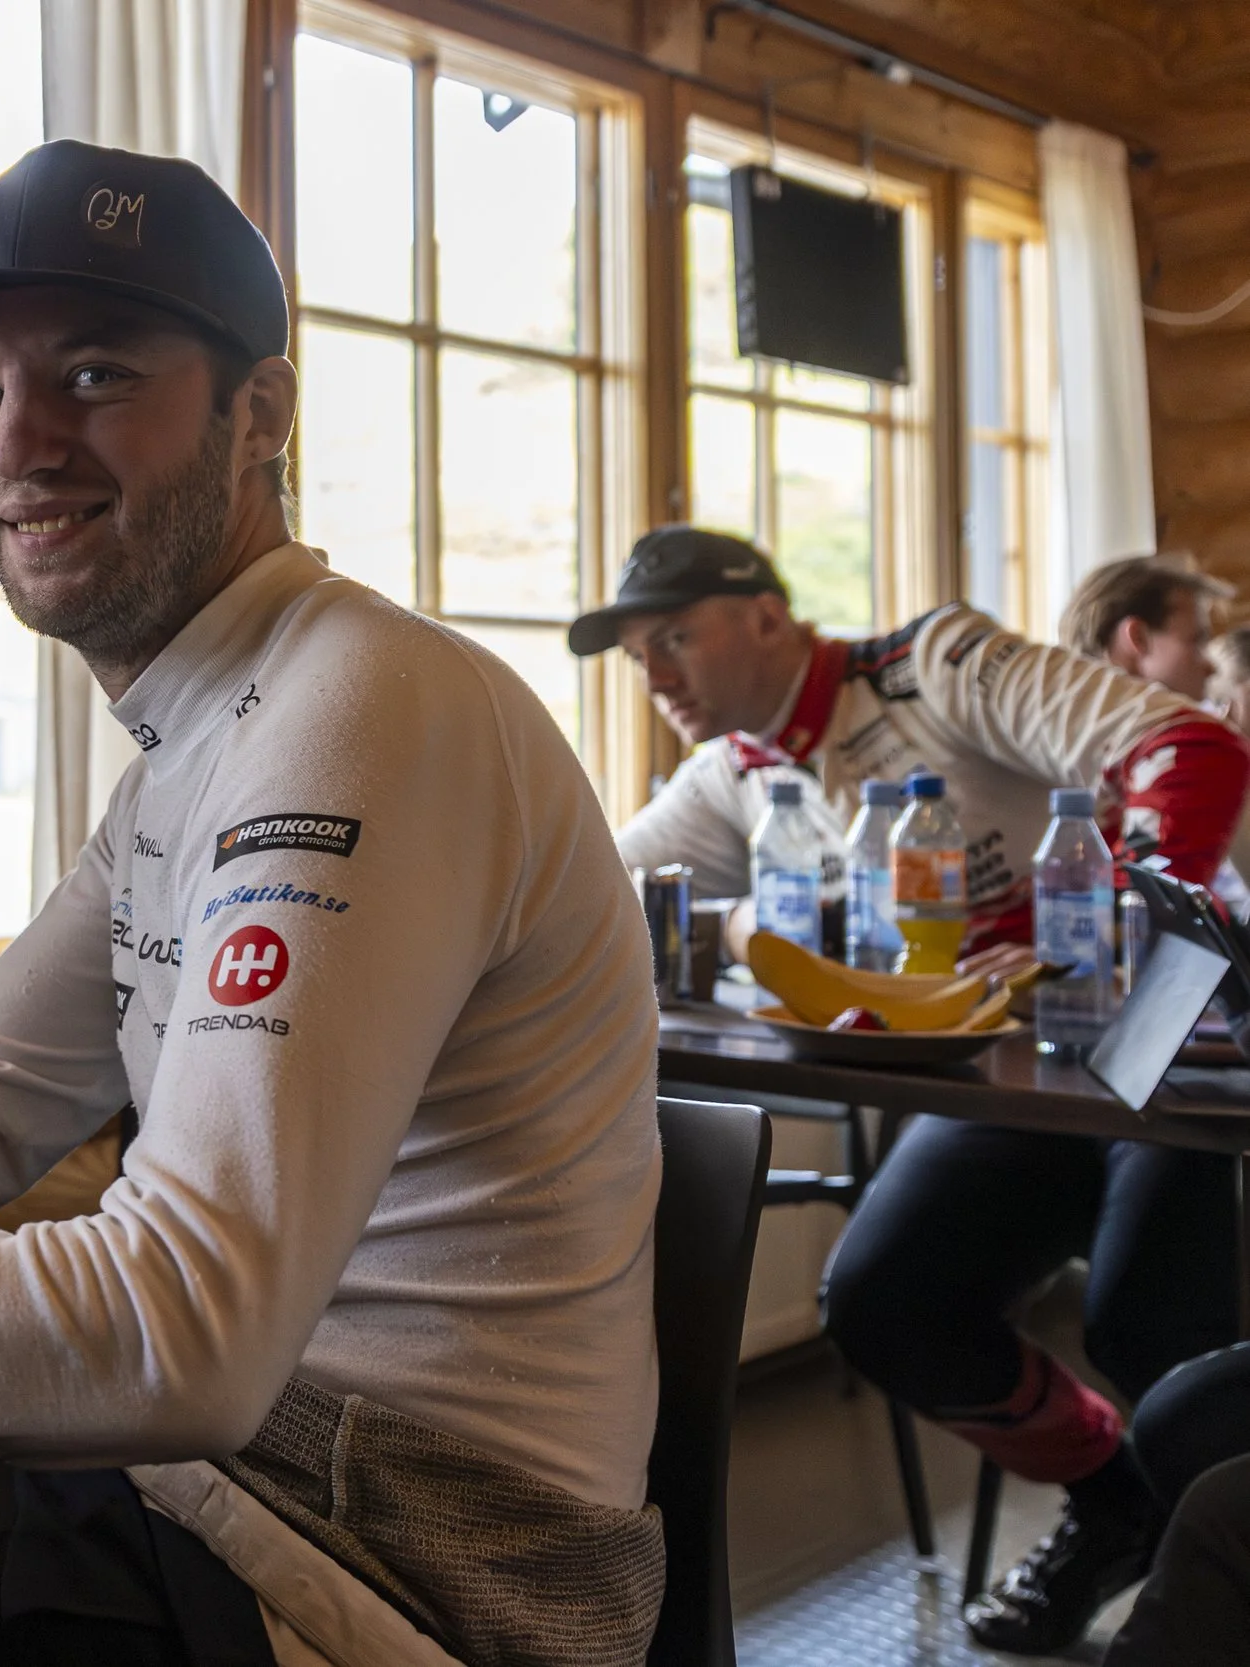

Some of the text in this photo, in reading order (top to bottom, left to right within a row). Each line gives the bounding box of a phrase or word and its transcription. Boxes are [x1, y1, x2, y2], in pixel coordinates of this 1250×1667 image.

[258, 834, 346, 849] driving emotion
[187, 1013, 290, 1036] TRENDAB
